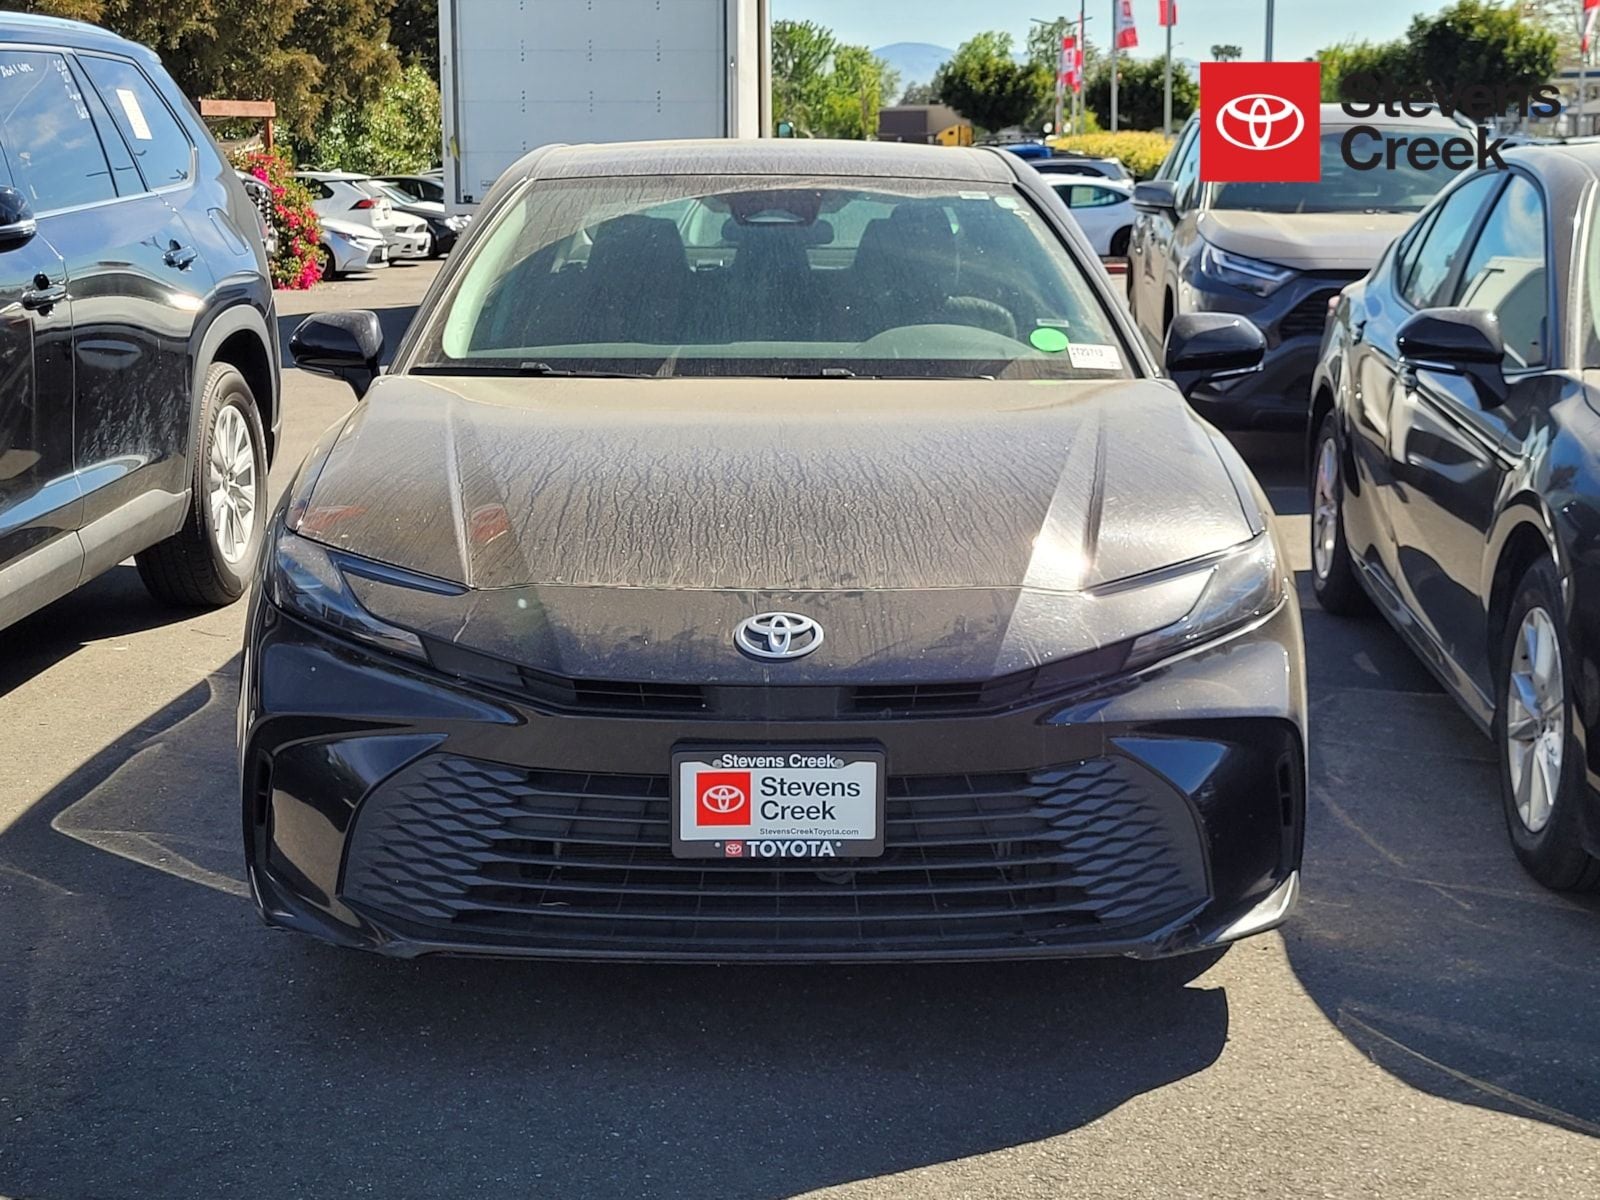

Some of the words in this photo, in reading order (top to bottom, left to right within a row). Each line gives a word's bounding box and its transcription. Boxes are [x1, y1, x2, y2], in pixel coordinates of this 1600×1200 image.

[205, 406, 219, 484] OKOHAMA
[722, 754, 784, 768] Stevens
[788, 754, 836, 768] Creek
[760, 776, 860, 797] Stevens
[760, 800, 836, 820] Creek
[759, 827, 859, 836] StevensCreekToyota.com
[746, 841, 835, 857] TOYOTA
